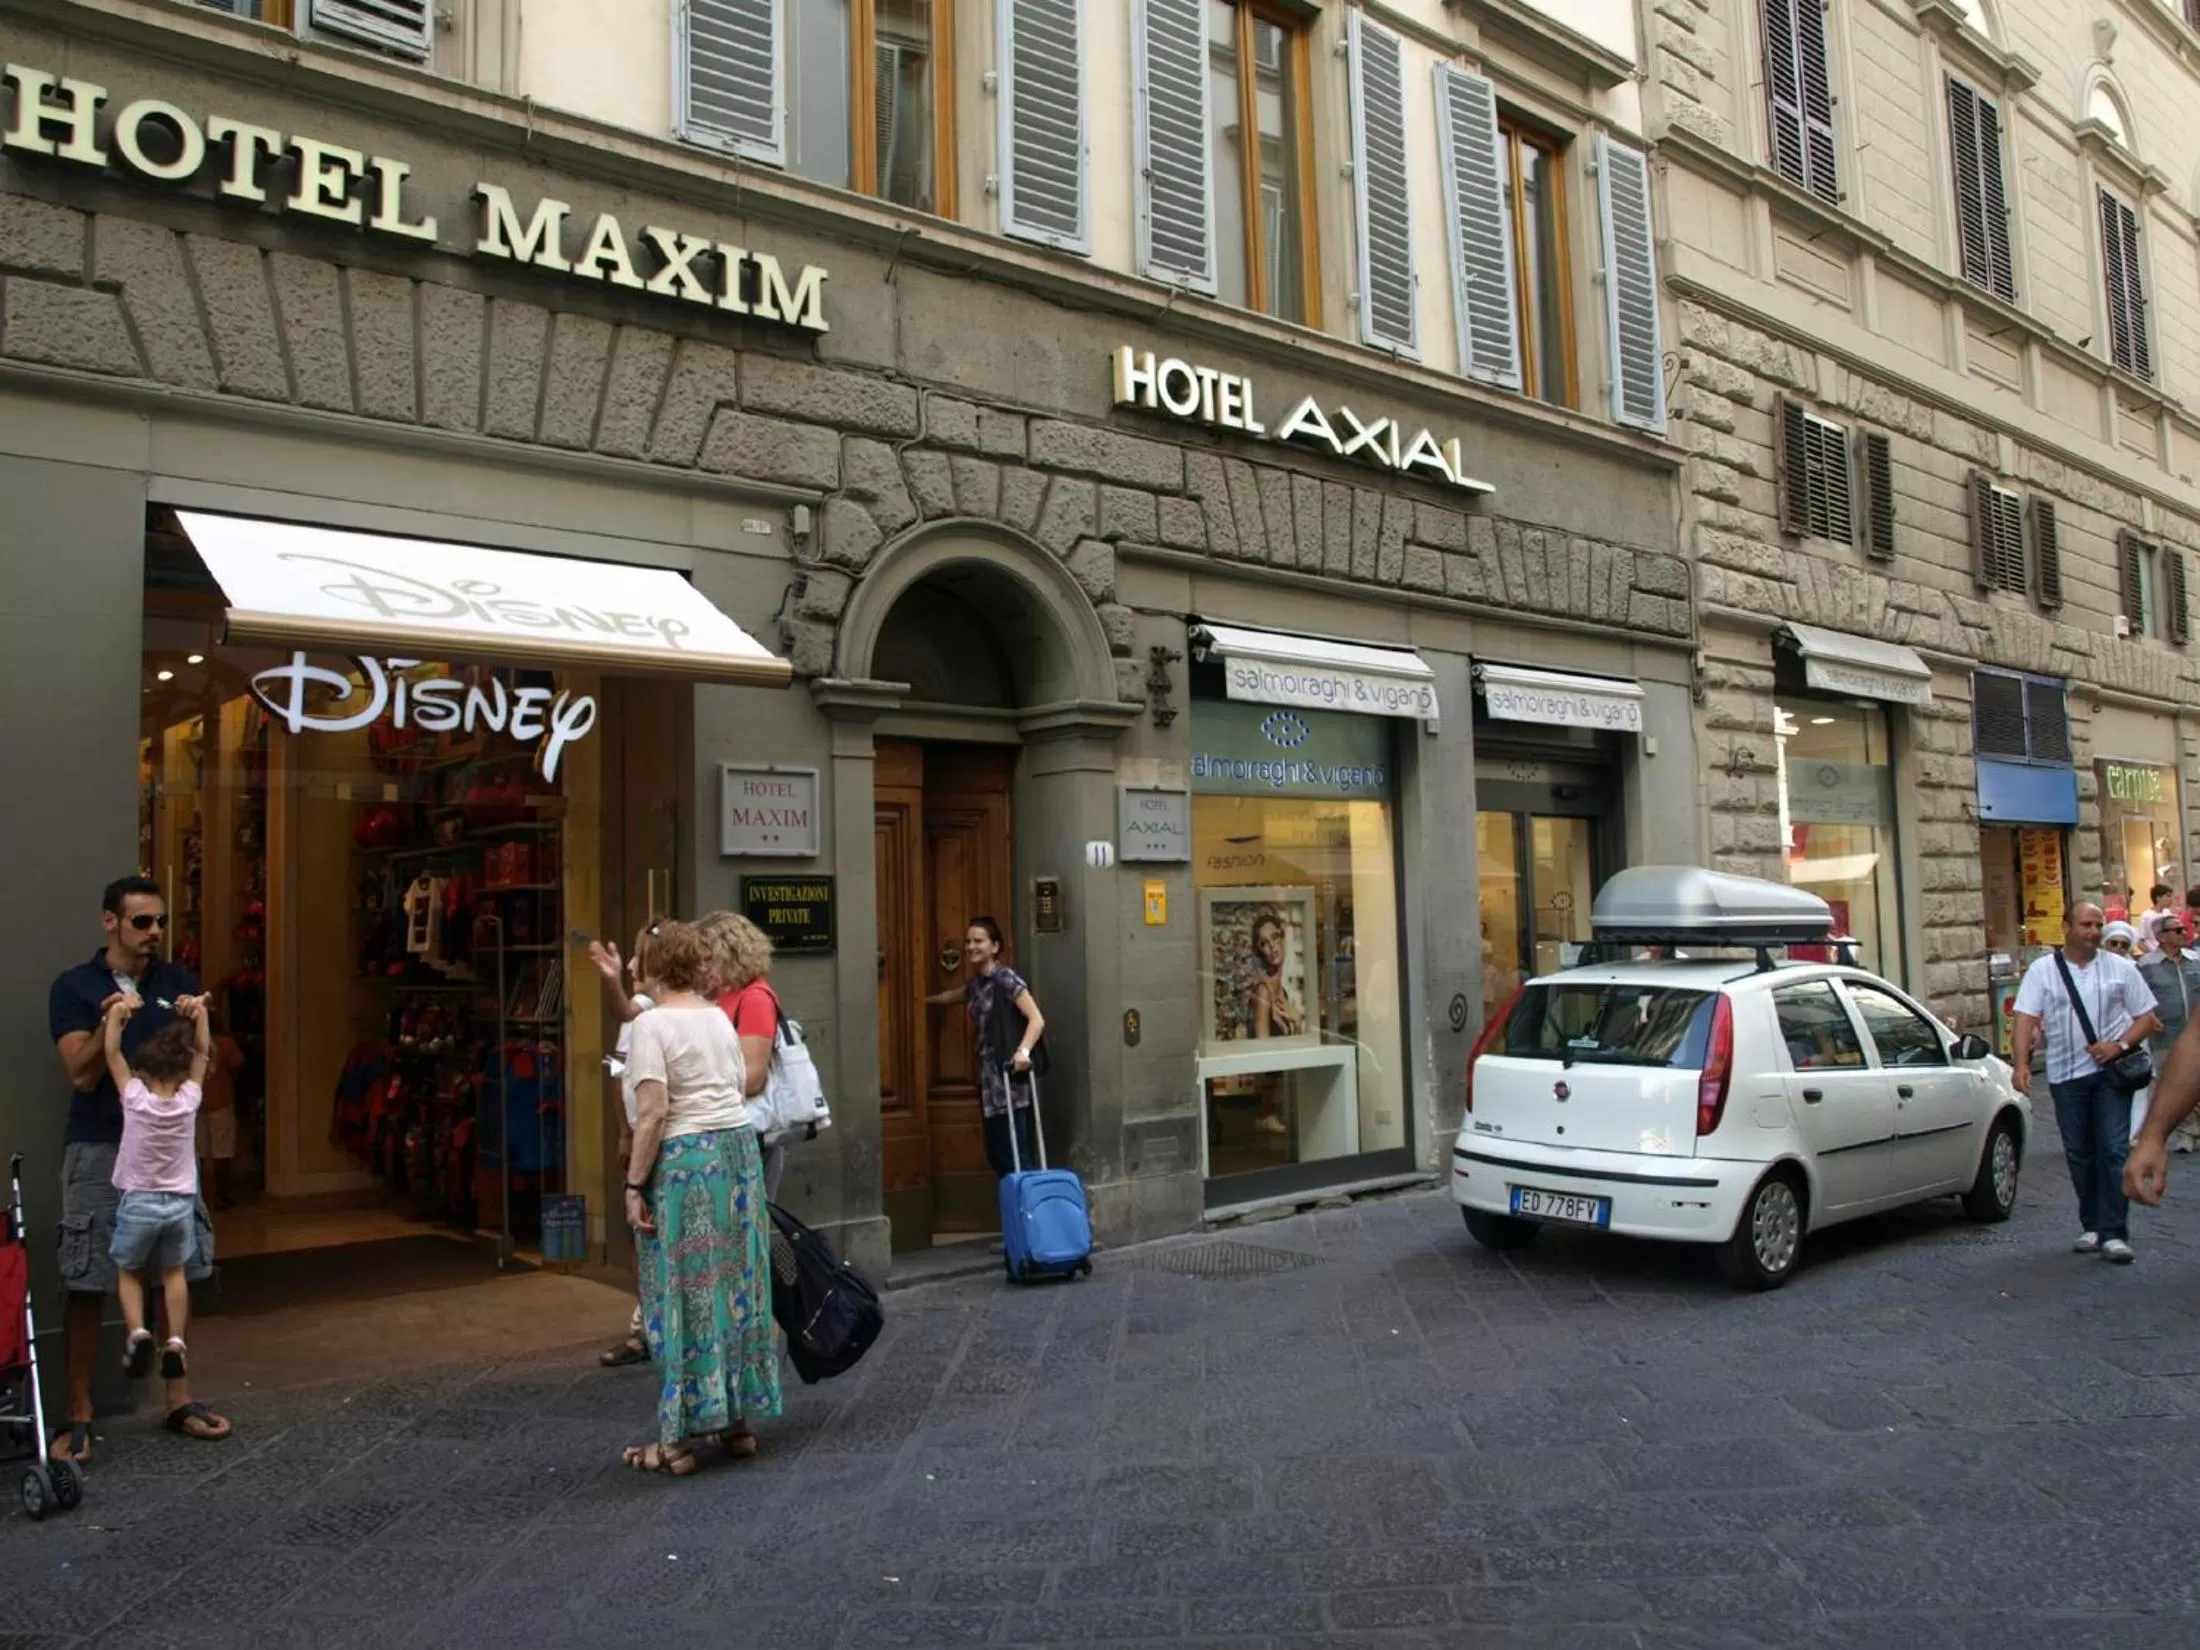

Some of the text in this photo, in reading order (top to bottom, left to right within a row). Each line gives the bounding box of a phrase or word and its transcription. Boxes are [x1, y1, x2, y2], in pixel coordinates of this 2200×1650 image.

[3, 62, 830, 335] HOTEL MAXIM
[1113, 345, 1497, 493] HOTEL AXIAL
[276, 552, 690, 648] Disney
[1234, 667, 1350, 703] salmoiraghi
[1355, 679, 1369, 701] &
[251, 650, 596, 783] Disney
[1491, 689, 1578, 720] salmoiraghi
[1579, 697, 1591, 717] &
[1192, 752, 1300, 789] almoiraghi
[1303, 760, 1318, 785] &
[743, 780, 798, 799] HOTEL
[732, 807, 808, 828] MAXIM
[1126, 821, 1184, 835] AXIAL
[1095, 844, 1106, 867] 11
[749, 886, 828, 902] INVESTIGAZIONI
[768, 910, 811, 925] PRIVATE
[1522, 1191, 1596, 1221] ED 778FV
